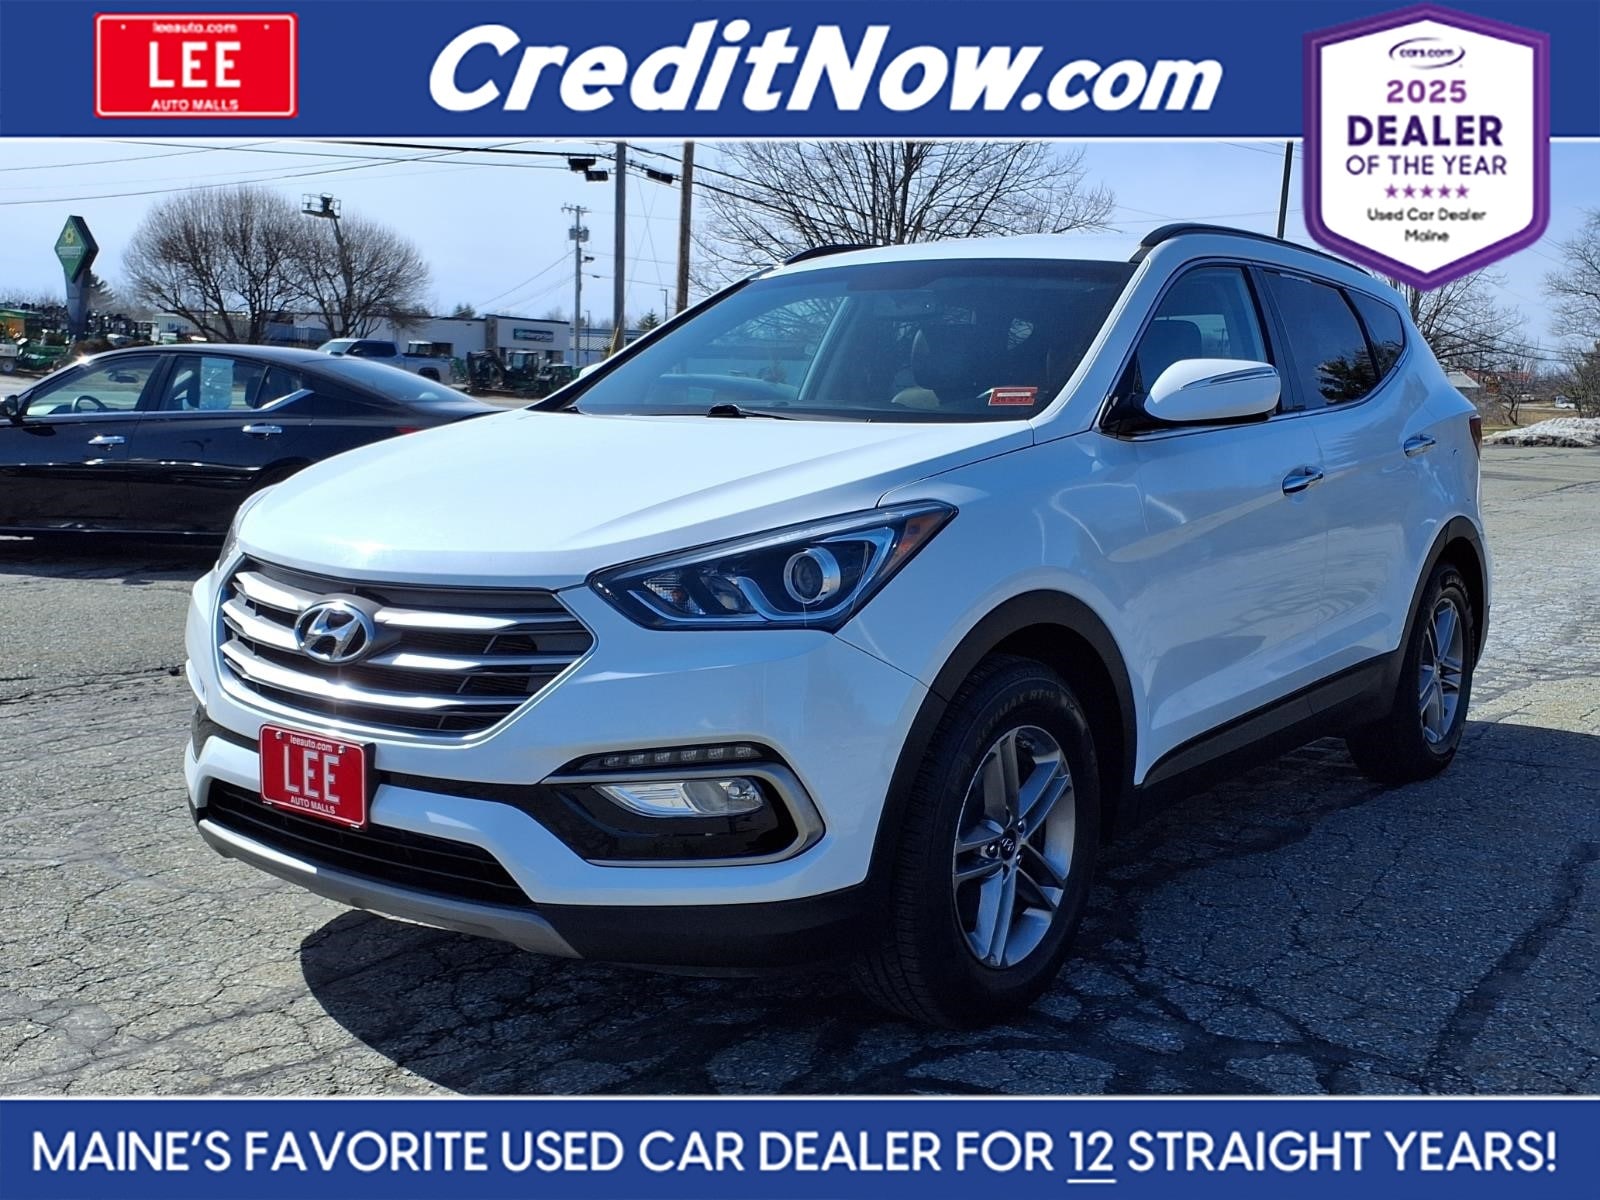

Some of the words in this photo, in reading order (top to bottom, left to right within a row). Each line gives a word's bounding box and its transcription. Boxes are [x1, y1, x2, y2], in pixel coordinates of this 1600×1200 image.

[290, 735, 333, 752] leeauto.com
[283, 744, 340, 803] LEE
[290, 795, 310, 808] AUTO
[311, 799, 336, 815] MALLS
